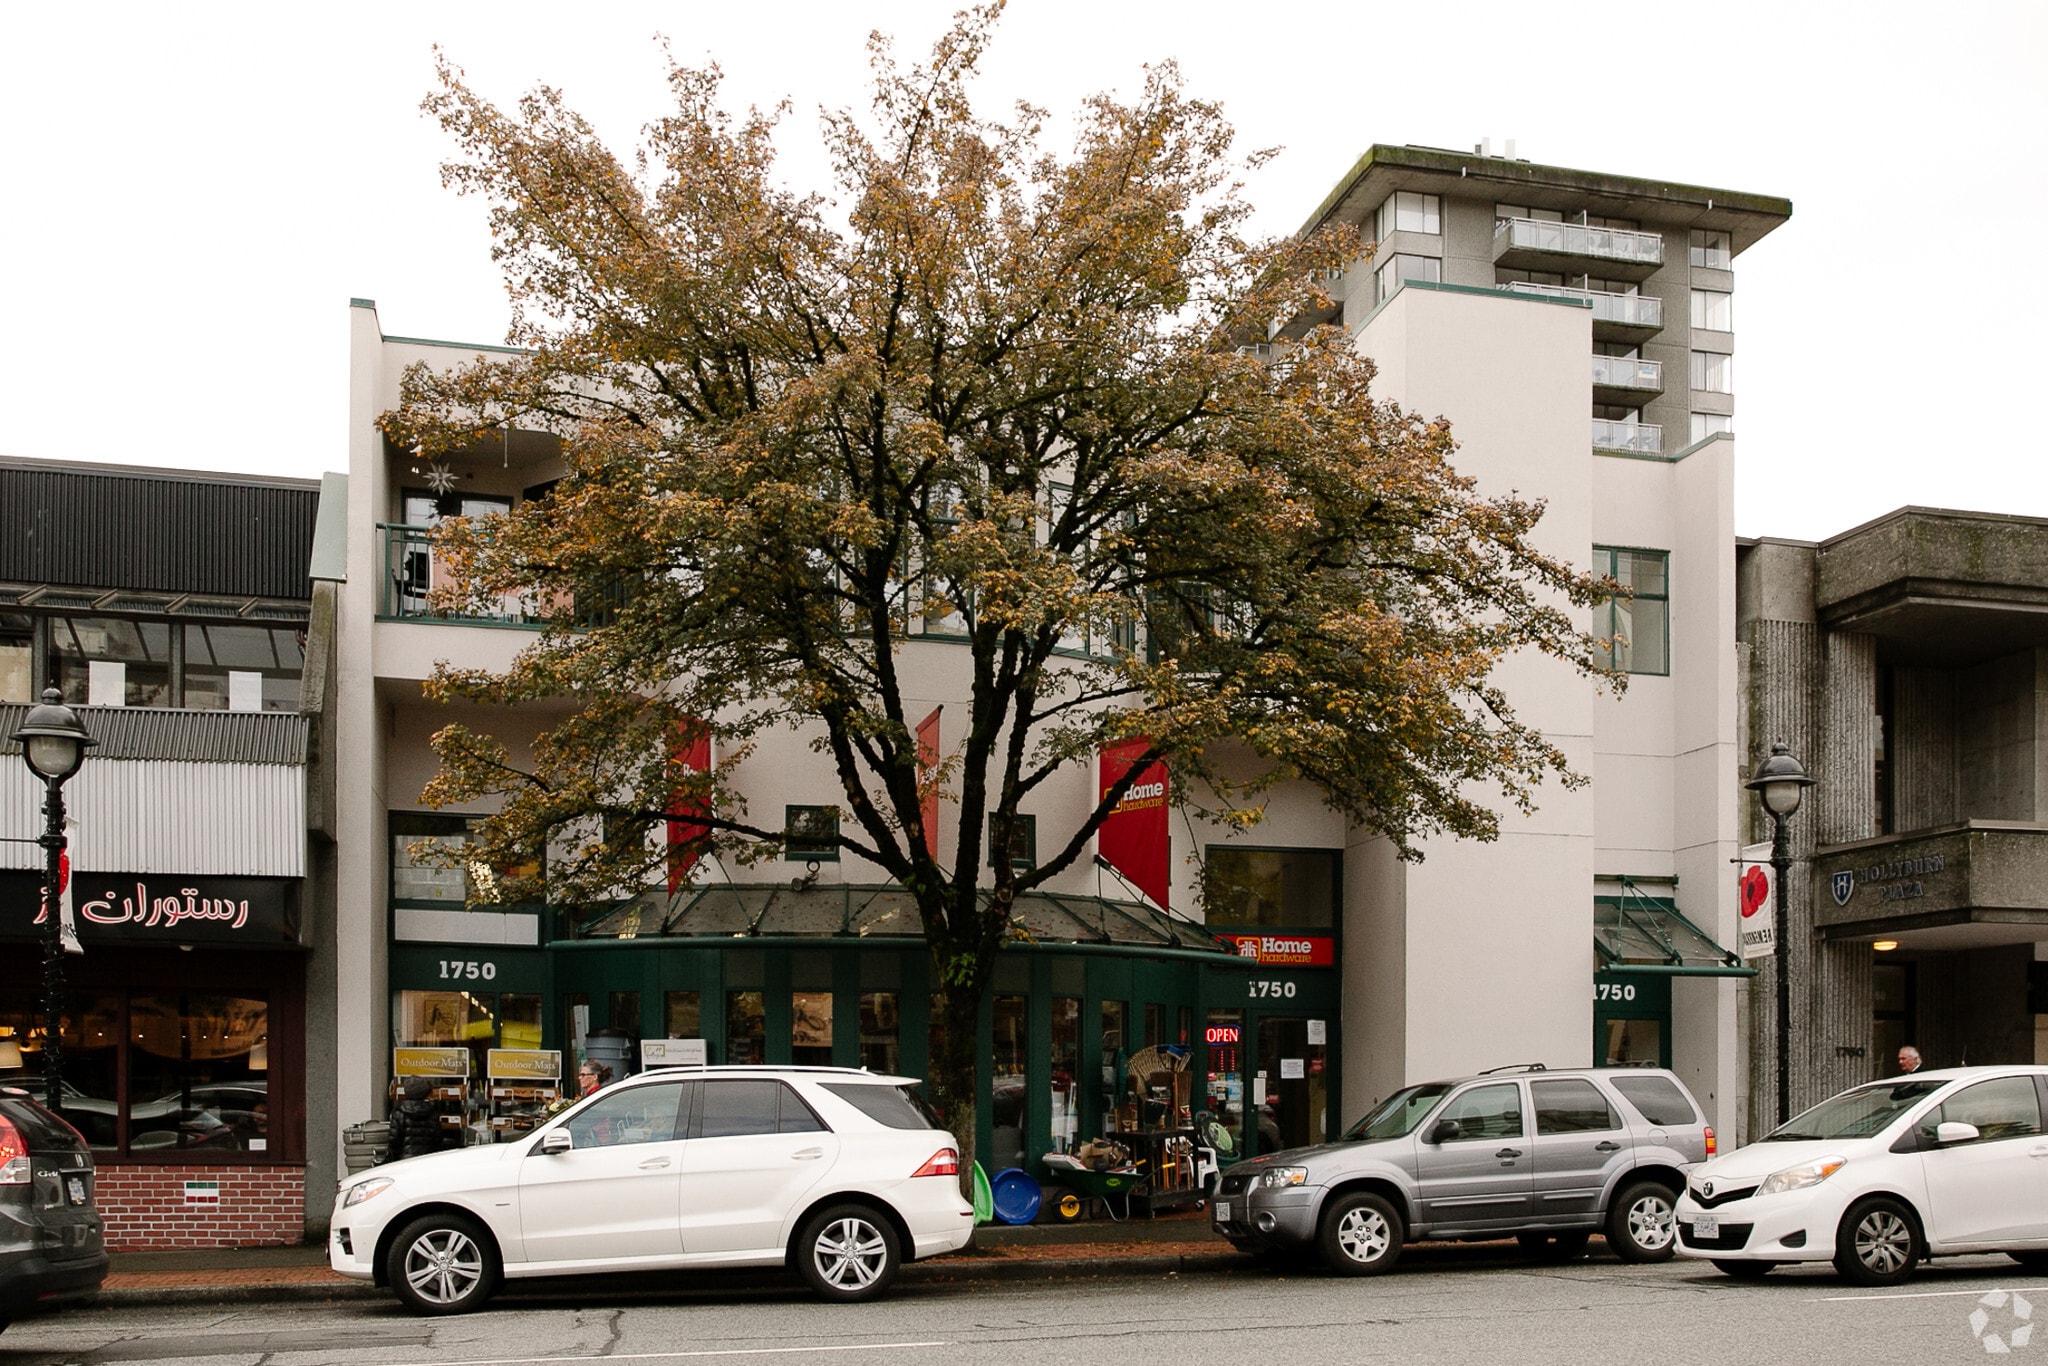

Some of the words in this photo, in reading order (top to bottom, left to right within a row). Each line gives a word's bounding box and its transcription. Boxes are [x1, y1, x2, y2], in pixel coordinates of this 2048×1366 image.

[1123, 797, 1164, 812] hardware
[1859, 855, 1945, 884] HOLLYBURN
[1878, 881, 1924, 901] PLAZA
[82, 882, 249, 929] رستوران
[1261, 937, 1312, 954] Home
[1261, 952, 1312, 963] hardware
[439, 960, 497, 980] 1750
[1248, 981, 1297, 998] 1750
[1206, 1028, 1239, 1043] OPEN
[400, 1057, 439, 1068] Outdoor
[441, 1058, 463, 1068] Mats
[494, 1059, 533, 1069] Outdoor
[534, 1060, 556, 1070] Mats
